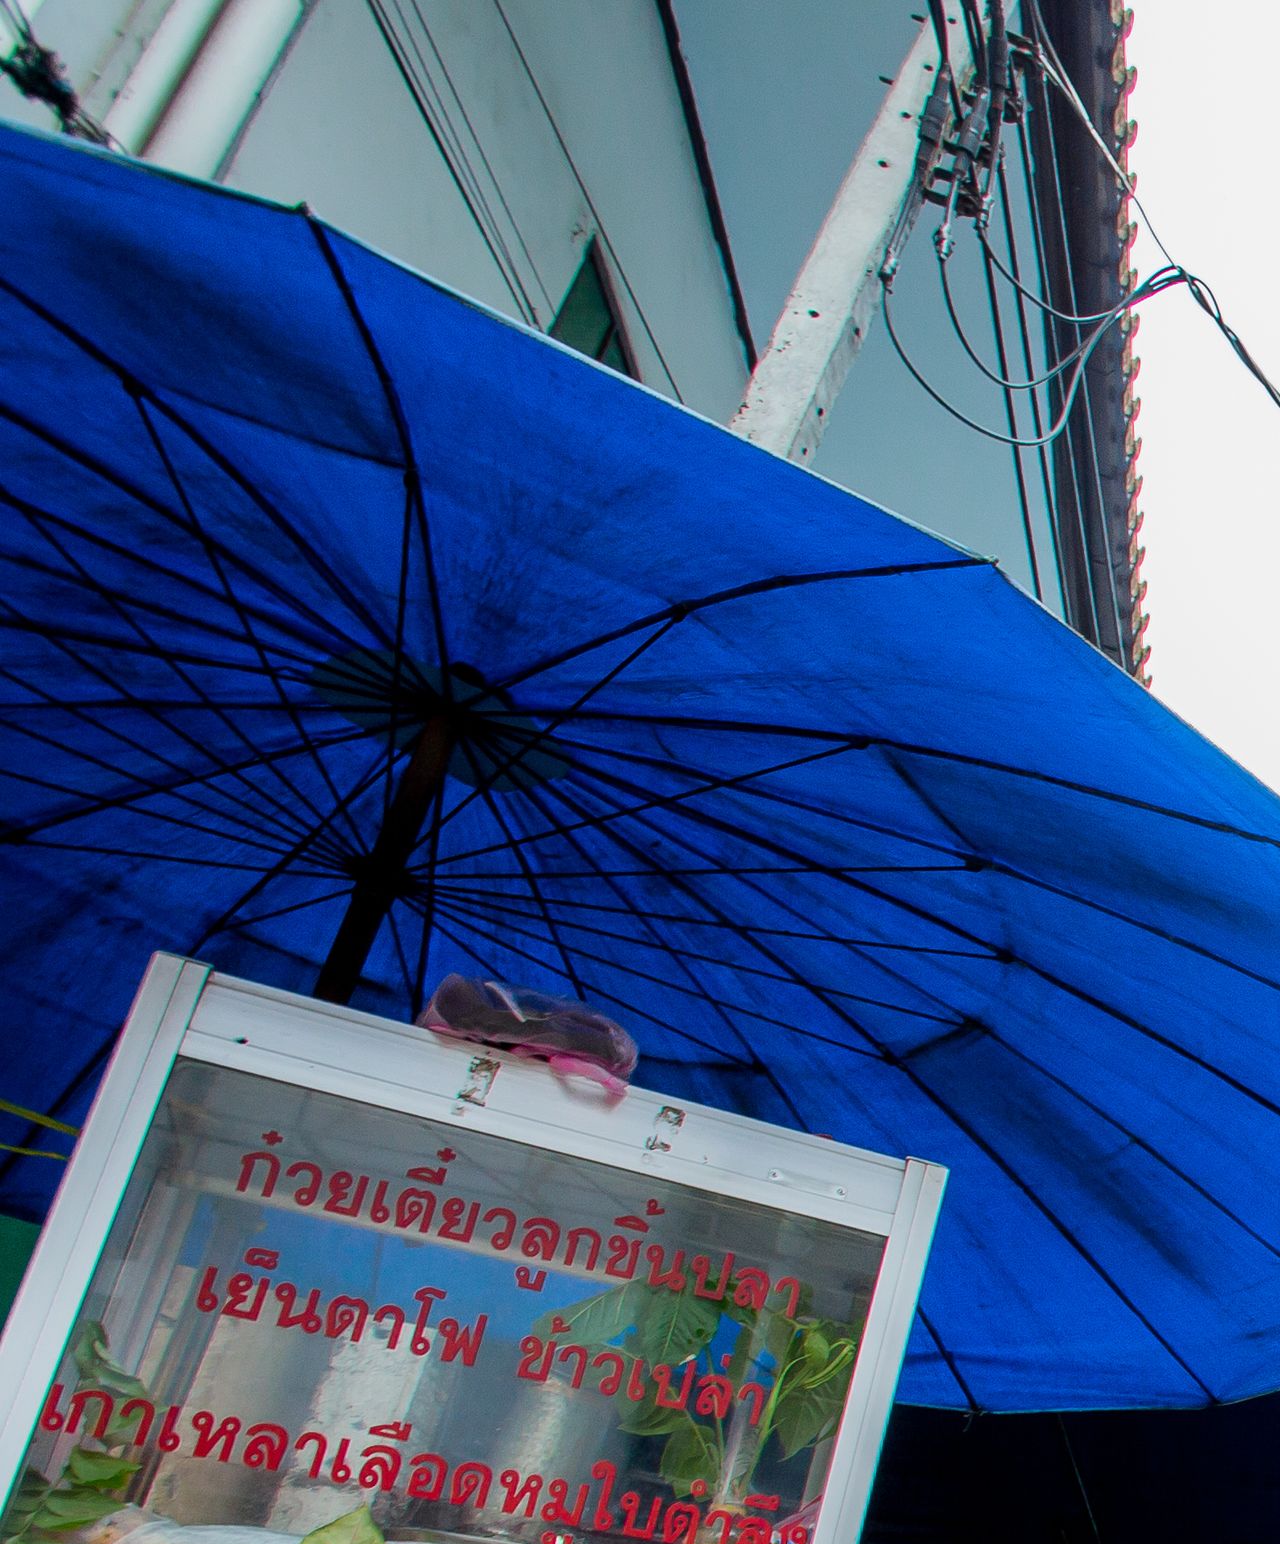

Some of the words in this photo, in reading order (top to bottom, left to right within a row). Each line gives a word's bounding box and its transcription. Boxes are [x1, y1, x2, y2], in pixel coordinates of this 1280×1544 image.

[234, 1130, 801, 1318] ก๋วยเตี๋ยวลูกชิ้นปลา
[195, 1247, 489, 1368] เย็นตาโฟ
[516, 1315, 768, 1426] ข้าวเปล่า
